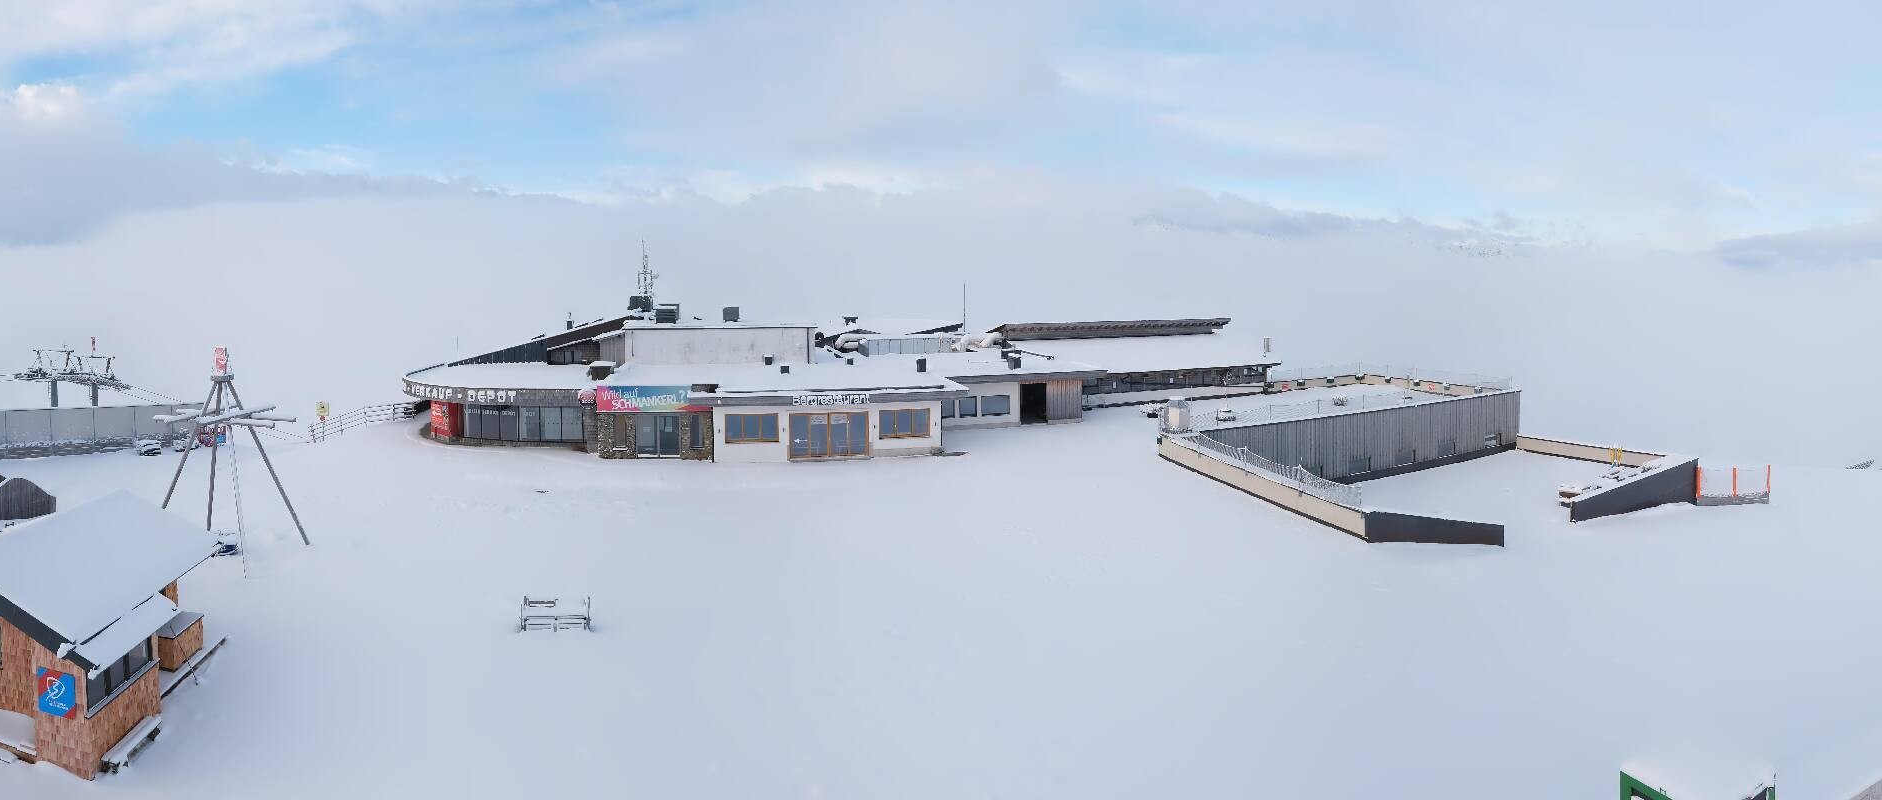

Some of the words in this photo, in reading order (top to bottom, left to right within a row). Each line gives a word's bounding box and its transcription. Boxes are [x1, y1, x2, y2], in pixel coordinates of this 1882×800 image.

[601, 389, 622, 401] Wild
[623, 388, 638, 399] auf
[792, 393, 870, 405] Bergrestaurant
